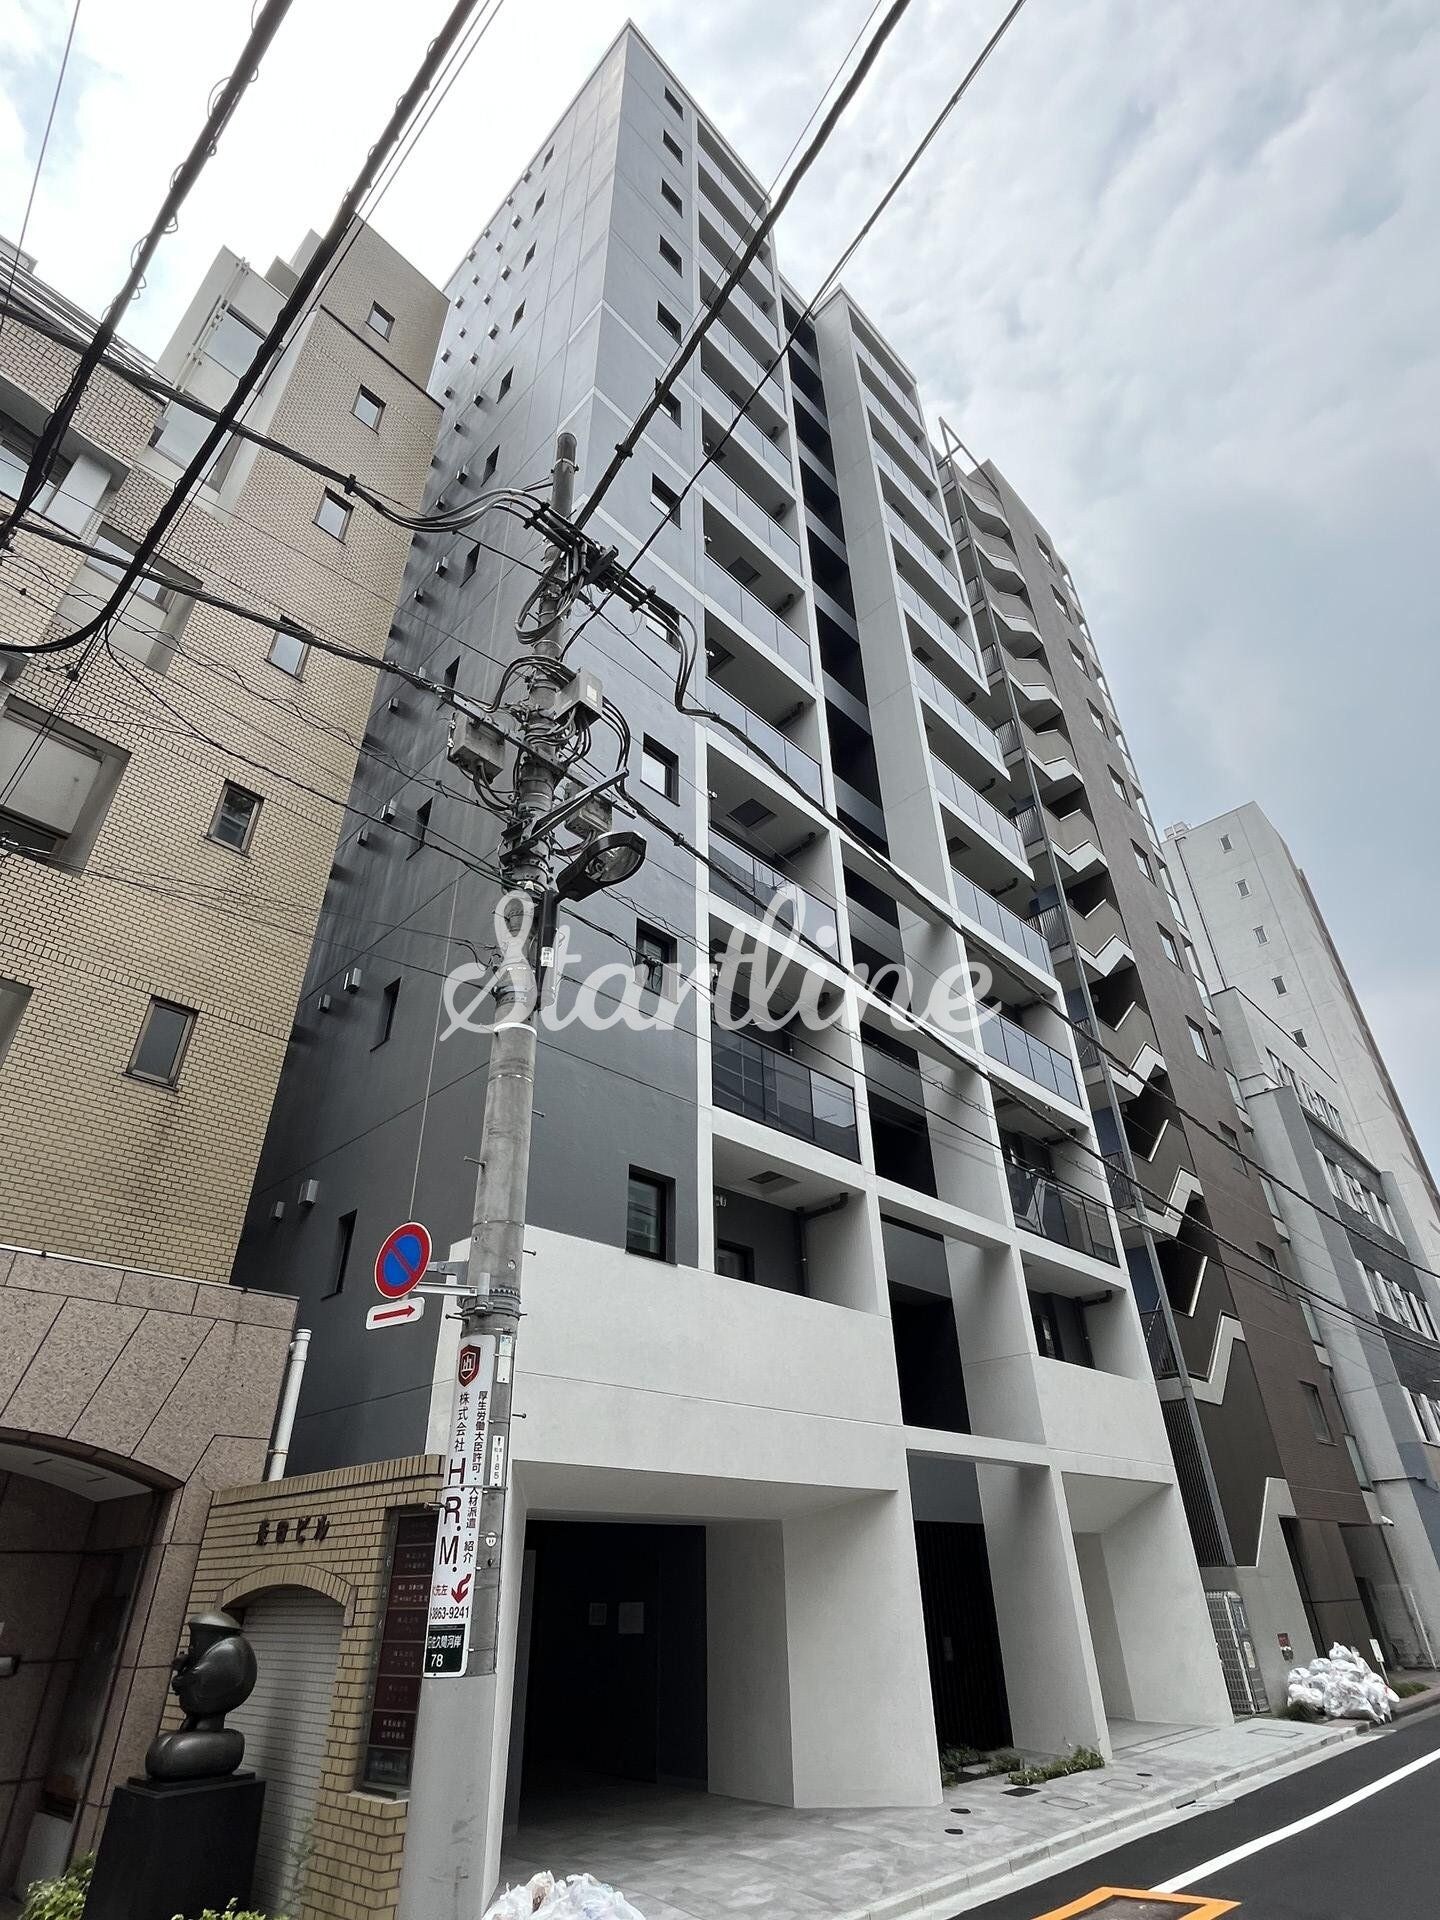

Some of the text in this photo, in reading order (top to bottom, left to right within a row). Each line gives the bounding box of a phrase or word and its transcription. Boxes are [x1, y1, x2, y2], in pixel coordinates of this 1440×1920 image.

[454, 1392, 470, 1453] 株式会社
[430, 1653, 444, 1668] 78
